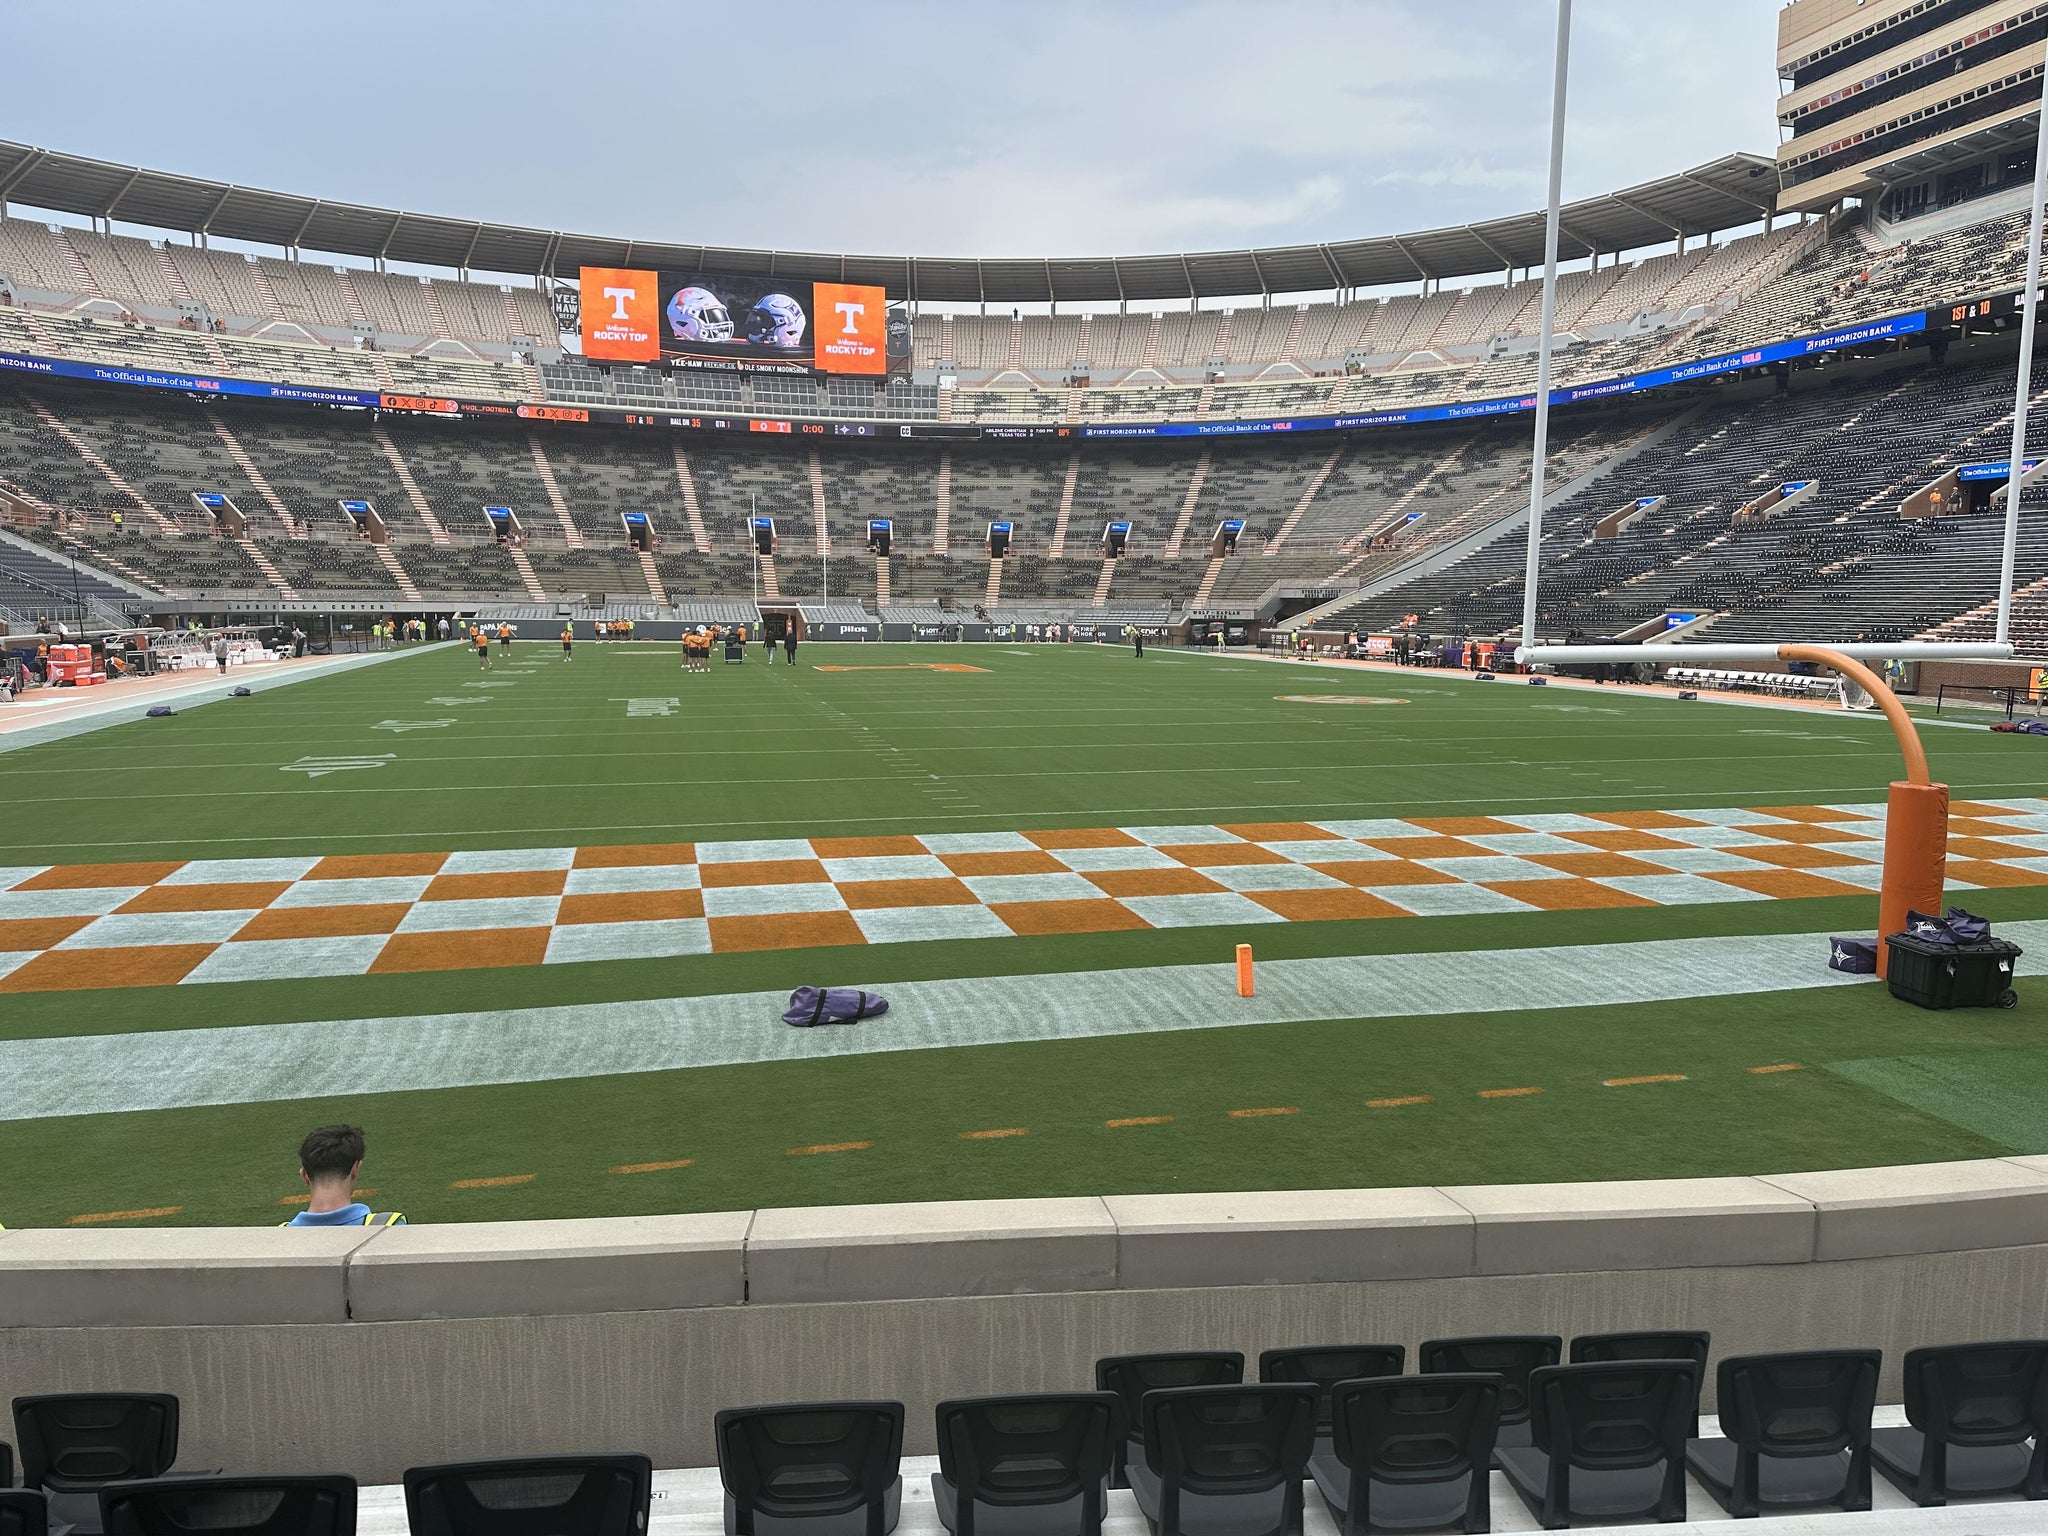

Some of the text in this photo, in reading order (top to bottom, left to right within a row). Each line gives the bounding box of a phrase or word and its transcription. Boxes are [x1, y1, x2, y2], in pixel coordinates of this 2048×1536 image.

[555, 293, 577, 304] YEE
[603, 287, 635, 319] T
[2014, 294, 2024, 306] BA
[556, 303, 577, 313] HAW
[1952, 300, 1990, 321] 1ST & 10
[559, 312, 574, 320] BEER
[835, 302, 864, 334] T
[593, 331, 648, 342] ROCKY TOP
[1814, 337, 1834, 348] FIRST
[1834, 331, 1867, 343] HORIZON
[1870, 324, 1893, 336] BANK
[825, 345, 875, 355] ROCKY TOP
[27, 361, 52, 371] BANK
[670, 359, 702, 367] YEE-HAW
[777, 365, 809, 374] MOONSHINE
[1672, 371, 1683, 379] The
[1683, 364, 1706, 376] Official
[1706, 362, 1722, 371] Bank
[1722, 359, 1730, 368] of
[1730, 358, 1740, 366] the
[95, 370, 111, 379] The
[112, 372, 144, 382] Official
[147, 376, 169, 385] Bank
[179, 379, 193, 387] the
[1578, 381, 1636, 397] FIRST HORIZON BANK
[279, 389, 358, 402] FIRST HORIZON BANK
[1461, 406, 1485, 415] Official
[625, 414, 654, 424] 1ST & 10
[670, 417, 682, 426] BALL
[692, 418, 701, 428] 35
[715, 420, 726, 428] QTR
[1360, 416, 1387, 424] HORIZON
[802, 424, 823, 433] 0:00
[858, 426, 865, 434] 0
[901, 427, 910, 436] CC
[1211, 425, 1235, 433] Official
